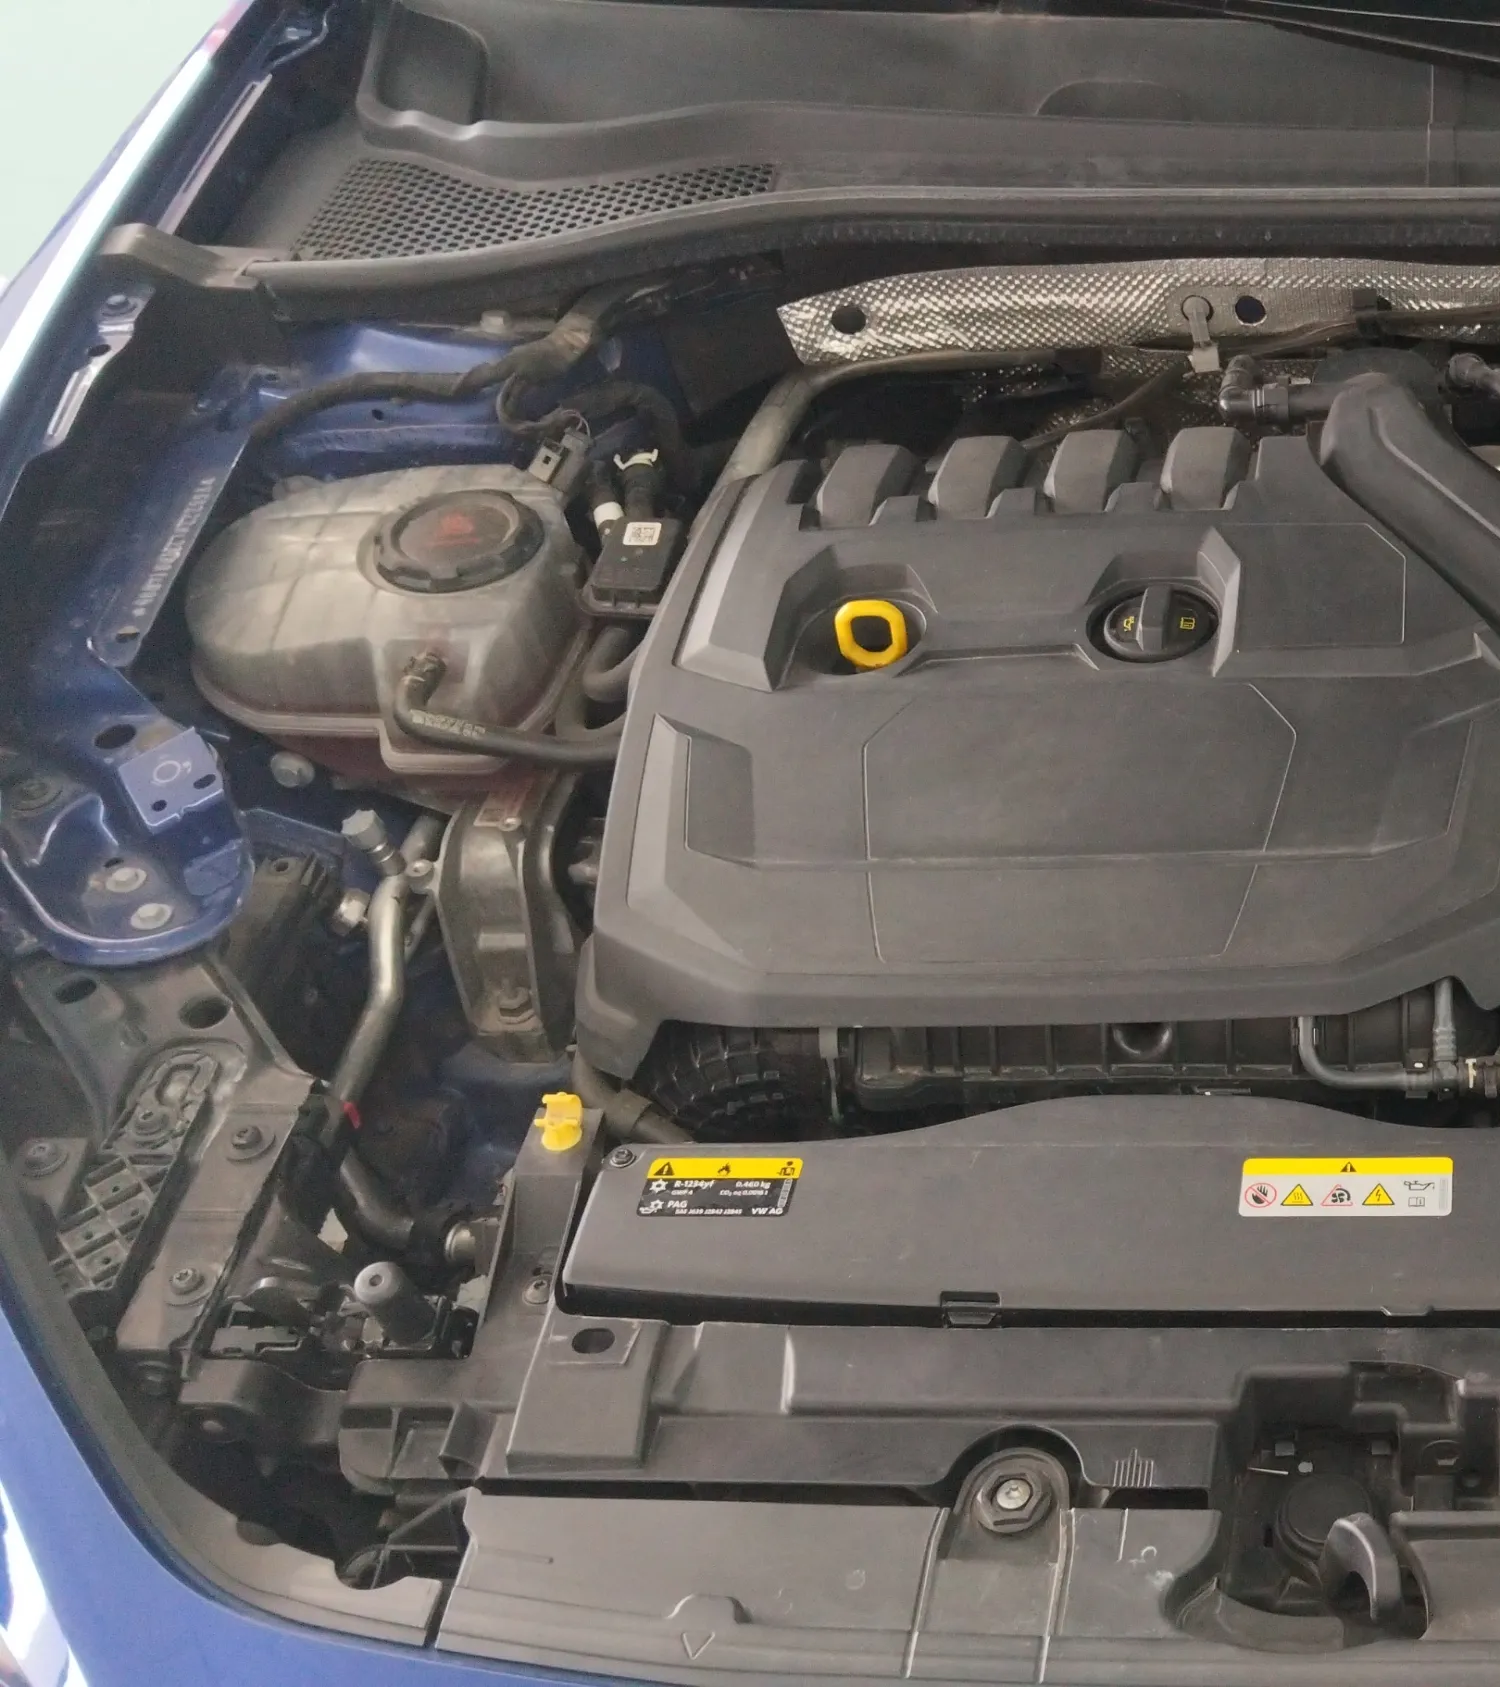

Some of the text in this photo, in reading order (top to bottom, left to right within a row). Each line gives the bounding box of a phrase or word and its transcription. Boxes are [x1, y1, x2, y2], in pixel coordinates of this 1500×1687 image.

[674, 1179, 716, 1190] R-1234yf
[760, 1180, 772, 1190] kg
[667, 1200, 688, 1208] PAG
[751, 1207, 768, 1215] VW
[769, 1207, 784, 1215] AG
